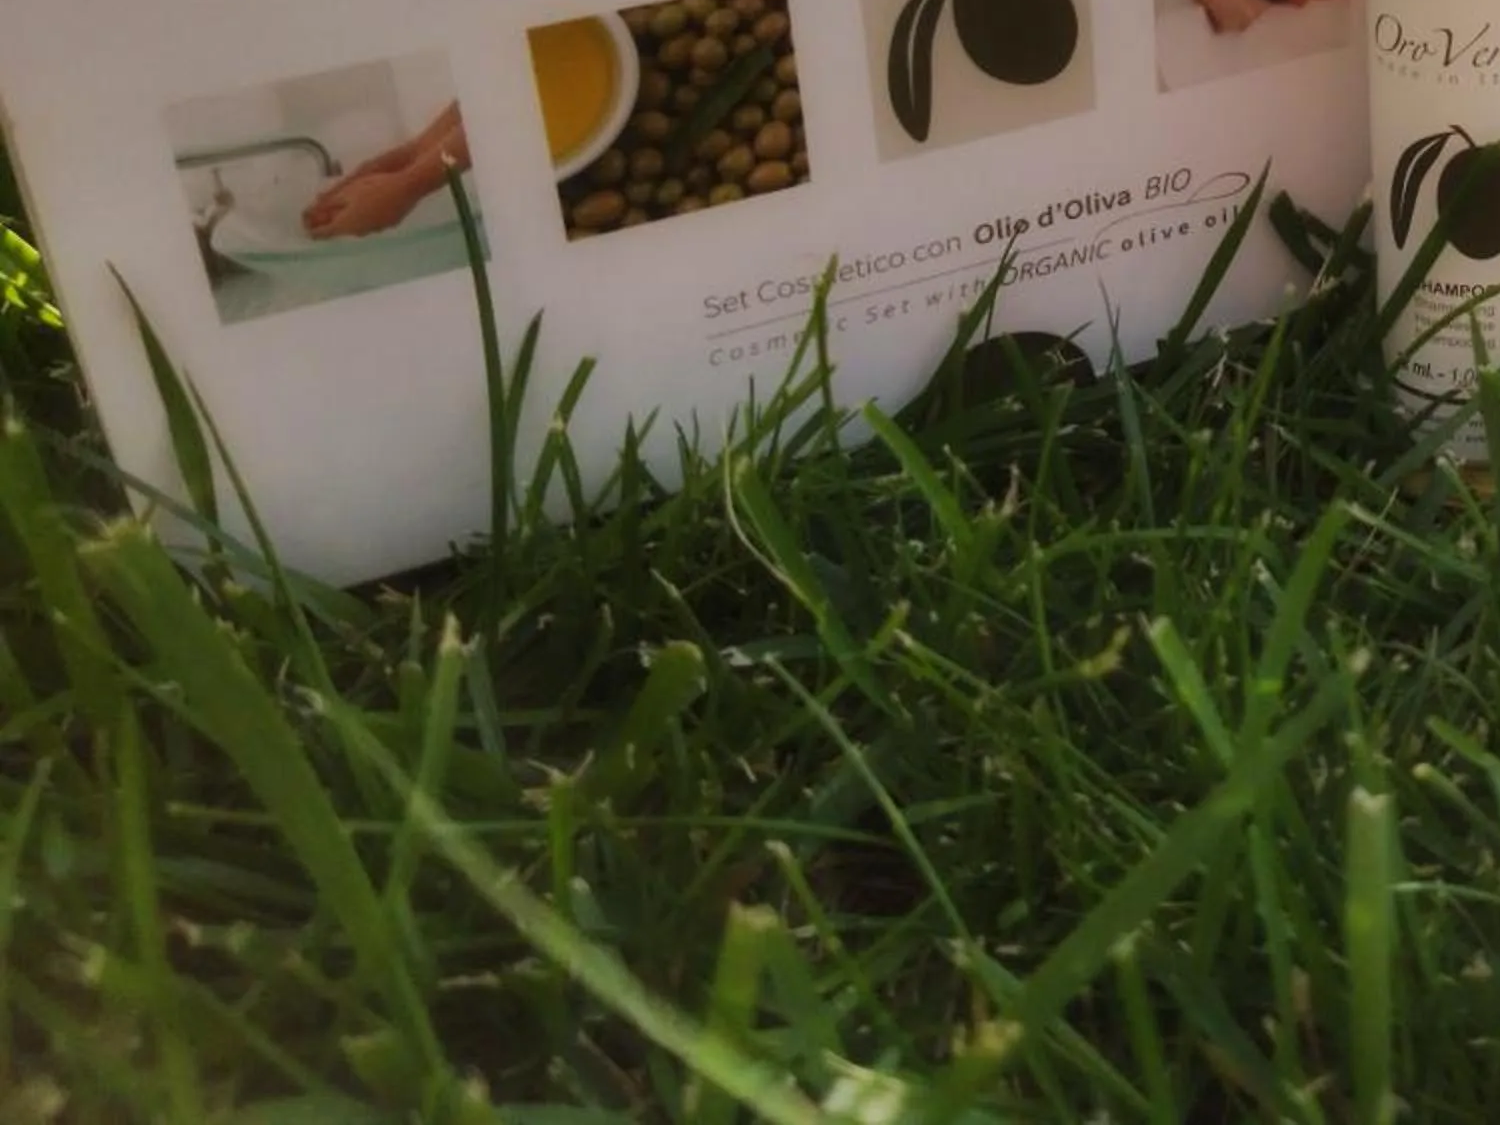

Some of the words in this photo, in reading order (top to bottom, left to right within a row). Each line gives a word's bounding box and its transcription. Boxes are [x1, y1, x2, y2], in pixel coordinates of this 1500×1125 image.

[1375, 12, 1437, 62] Oro
[703, 291, 751, 320] Set
[757, 251, 906, 306] Cosetico
[912, 236, 962, 263] con
[973, 218, 1030, 245] Olio
[1036, 189, 1132, 228] d'Oliva
[1145, 168, 1192, 201] BIO
[865, 299, 911, 325] Set
[926, 277, 987, 307] with
[1000, 239, 1113, 287] ORGANIC
[1121, 222, 1190, 253] olive
[1204, 205, 1242, 228] oil
